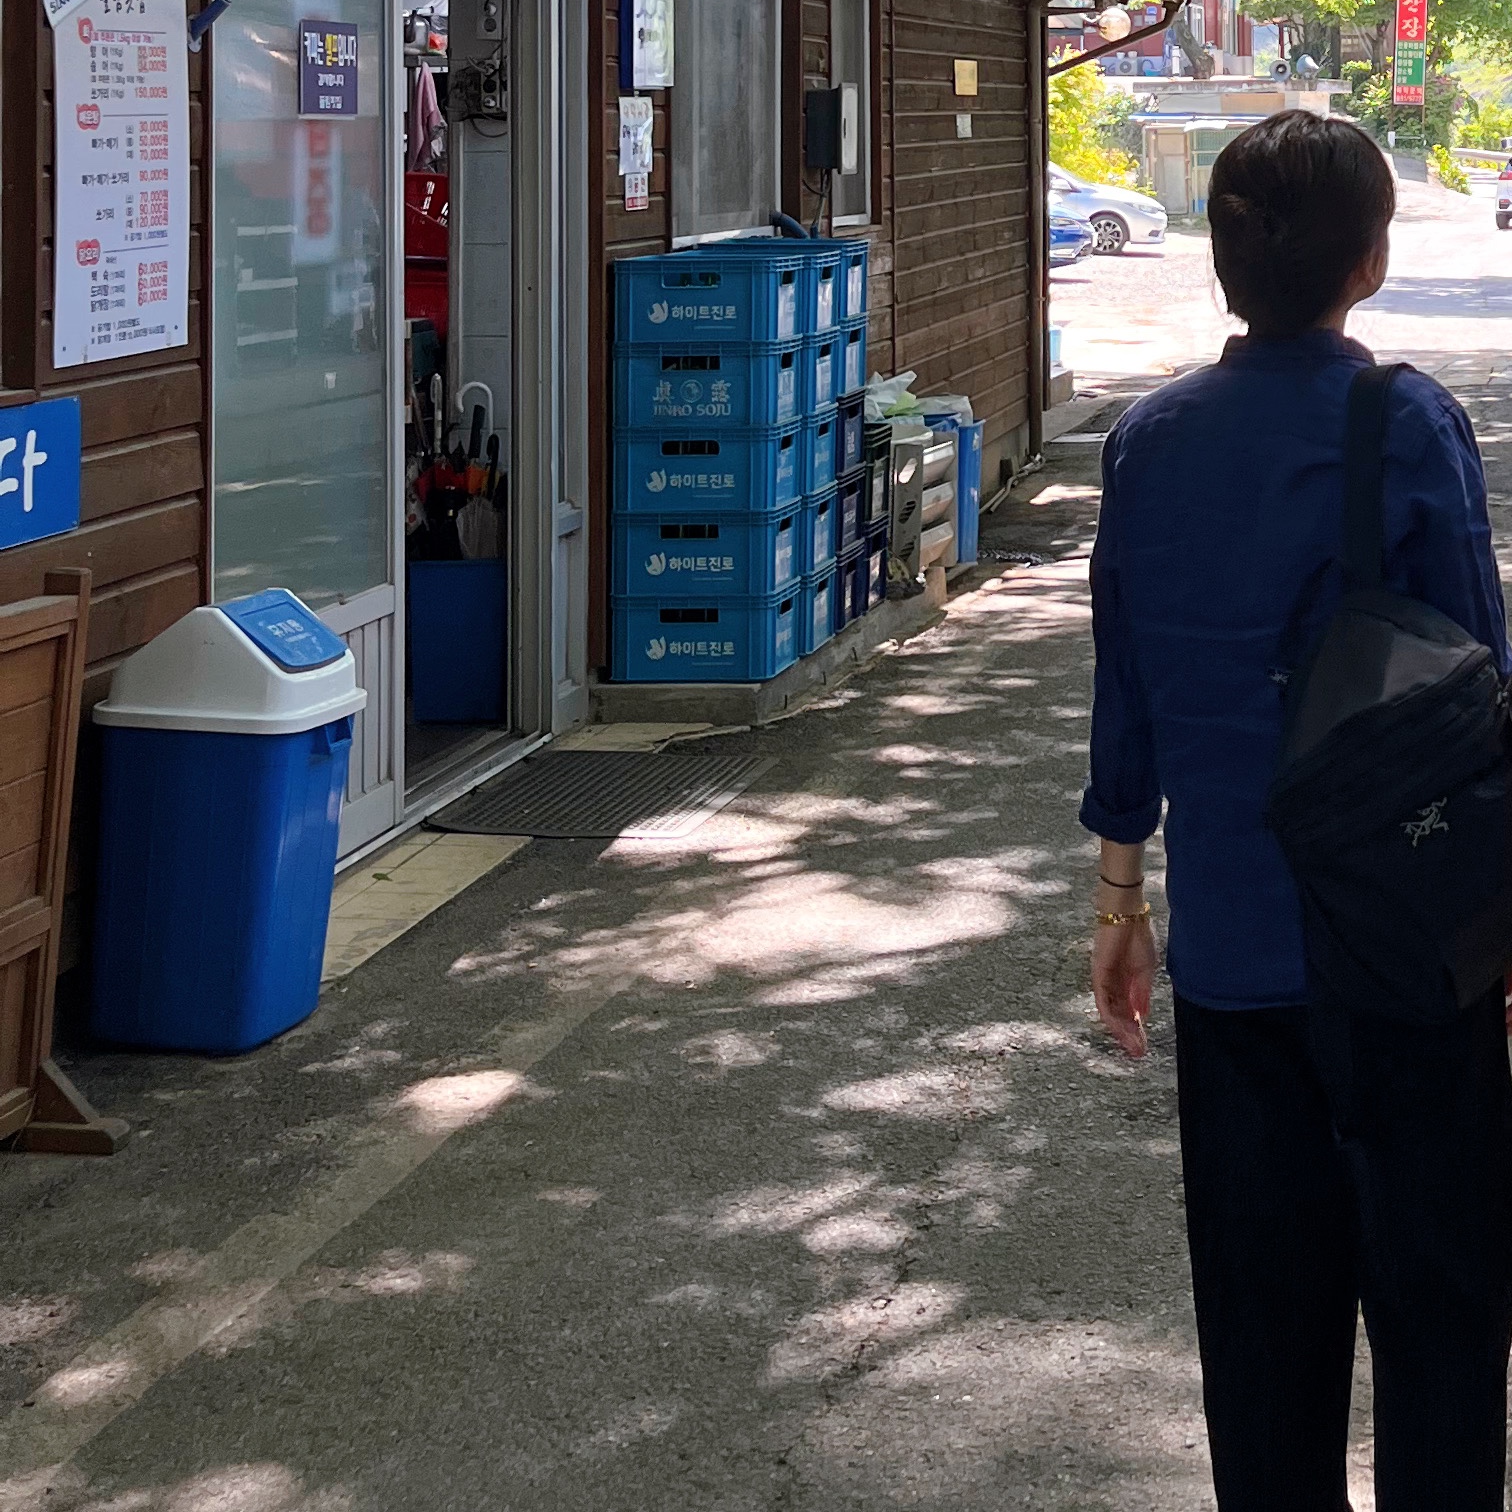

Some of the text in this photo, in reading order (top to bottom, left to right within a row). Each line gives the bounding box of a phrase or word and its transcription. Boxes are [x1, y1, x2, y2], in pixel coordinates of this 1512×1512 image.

[671, 305, 737, 322] 하이트진로
[654, 403, 732, 417] JINRO SOJU
[669, 473, 736, 489] 하이트진로
[669, 556, 735, 572] 하이트진로
[669, 641, 736, 657] 하이트진로
